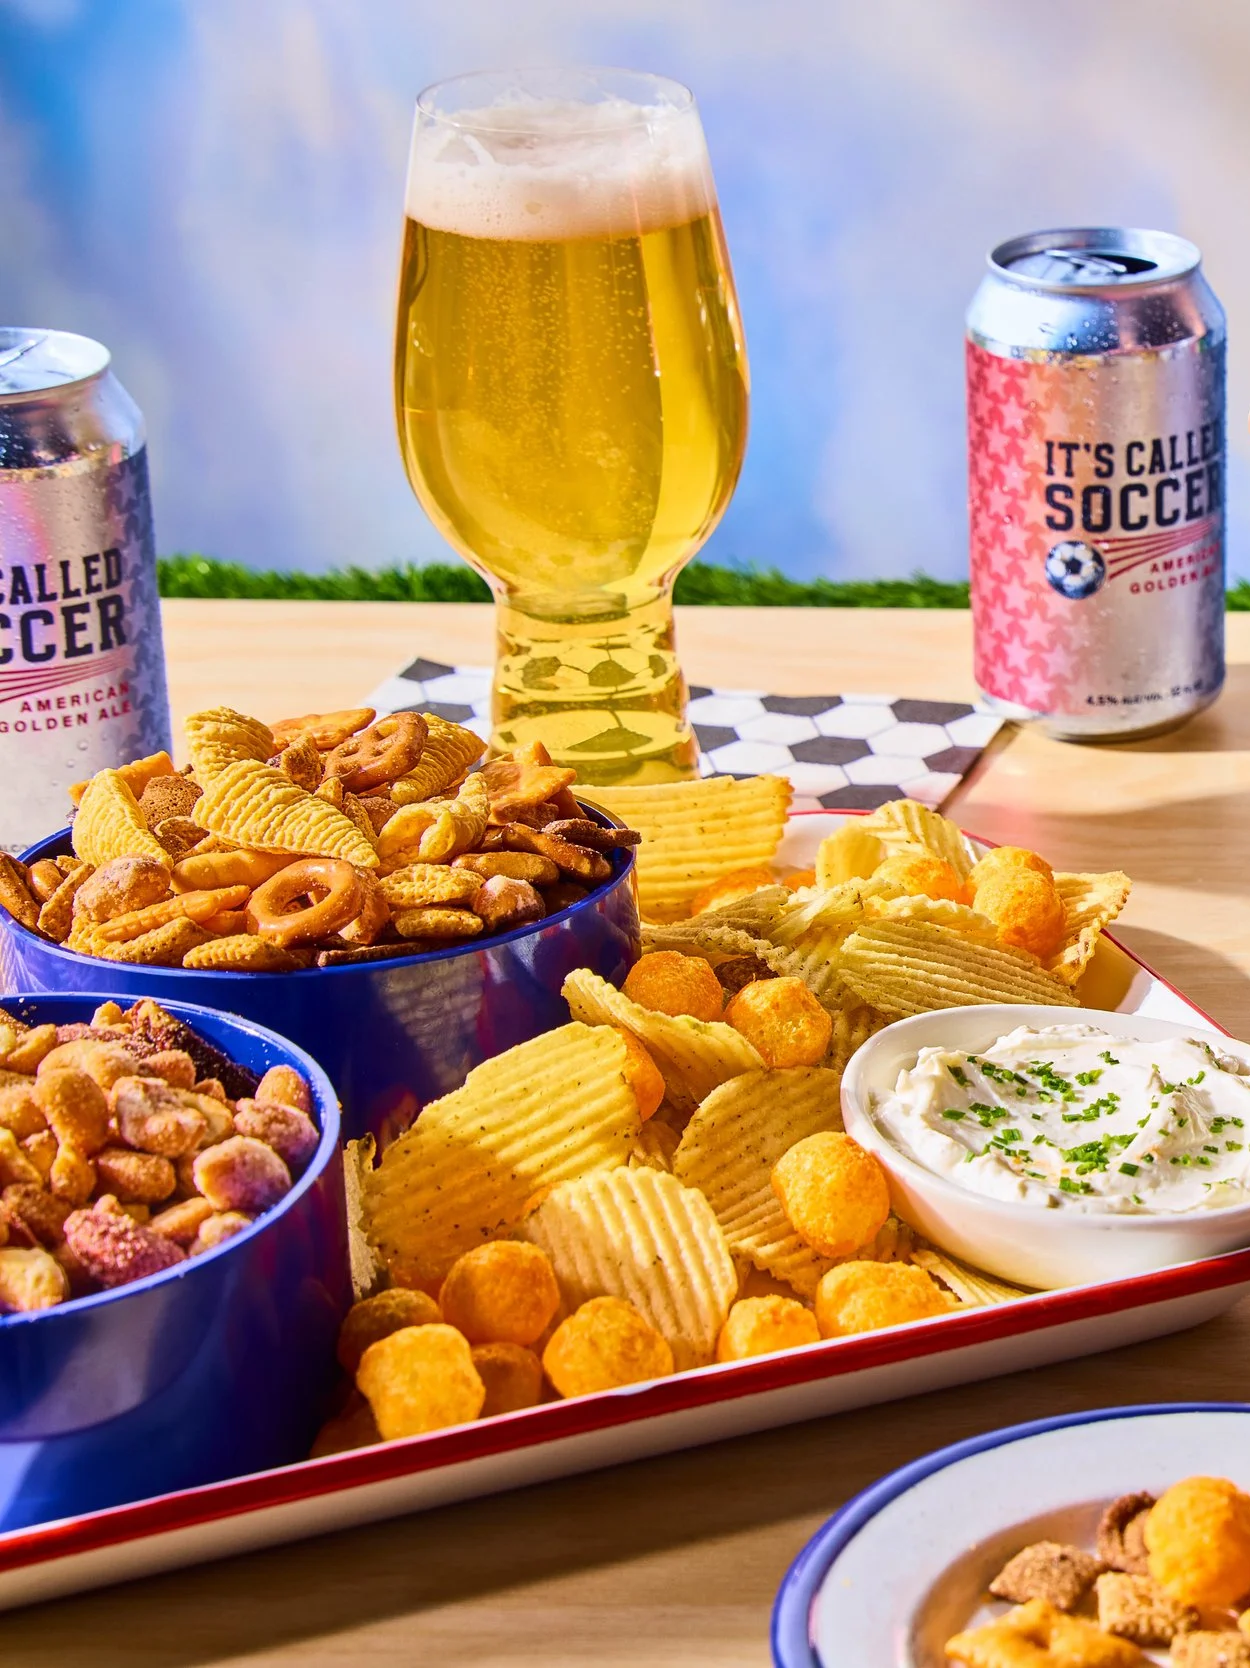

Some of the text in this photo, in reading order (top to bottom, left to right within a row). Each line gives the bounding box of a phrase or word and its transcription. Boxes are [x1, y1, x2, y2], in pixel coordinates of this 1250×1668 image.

[1045, 441, 1115, 478] IT'S
[0, 548, 122, 605] ALLED
[20, 680, 130, 712] AMERICAN
[99, 701, 132, 720] ALE
